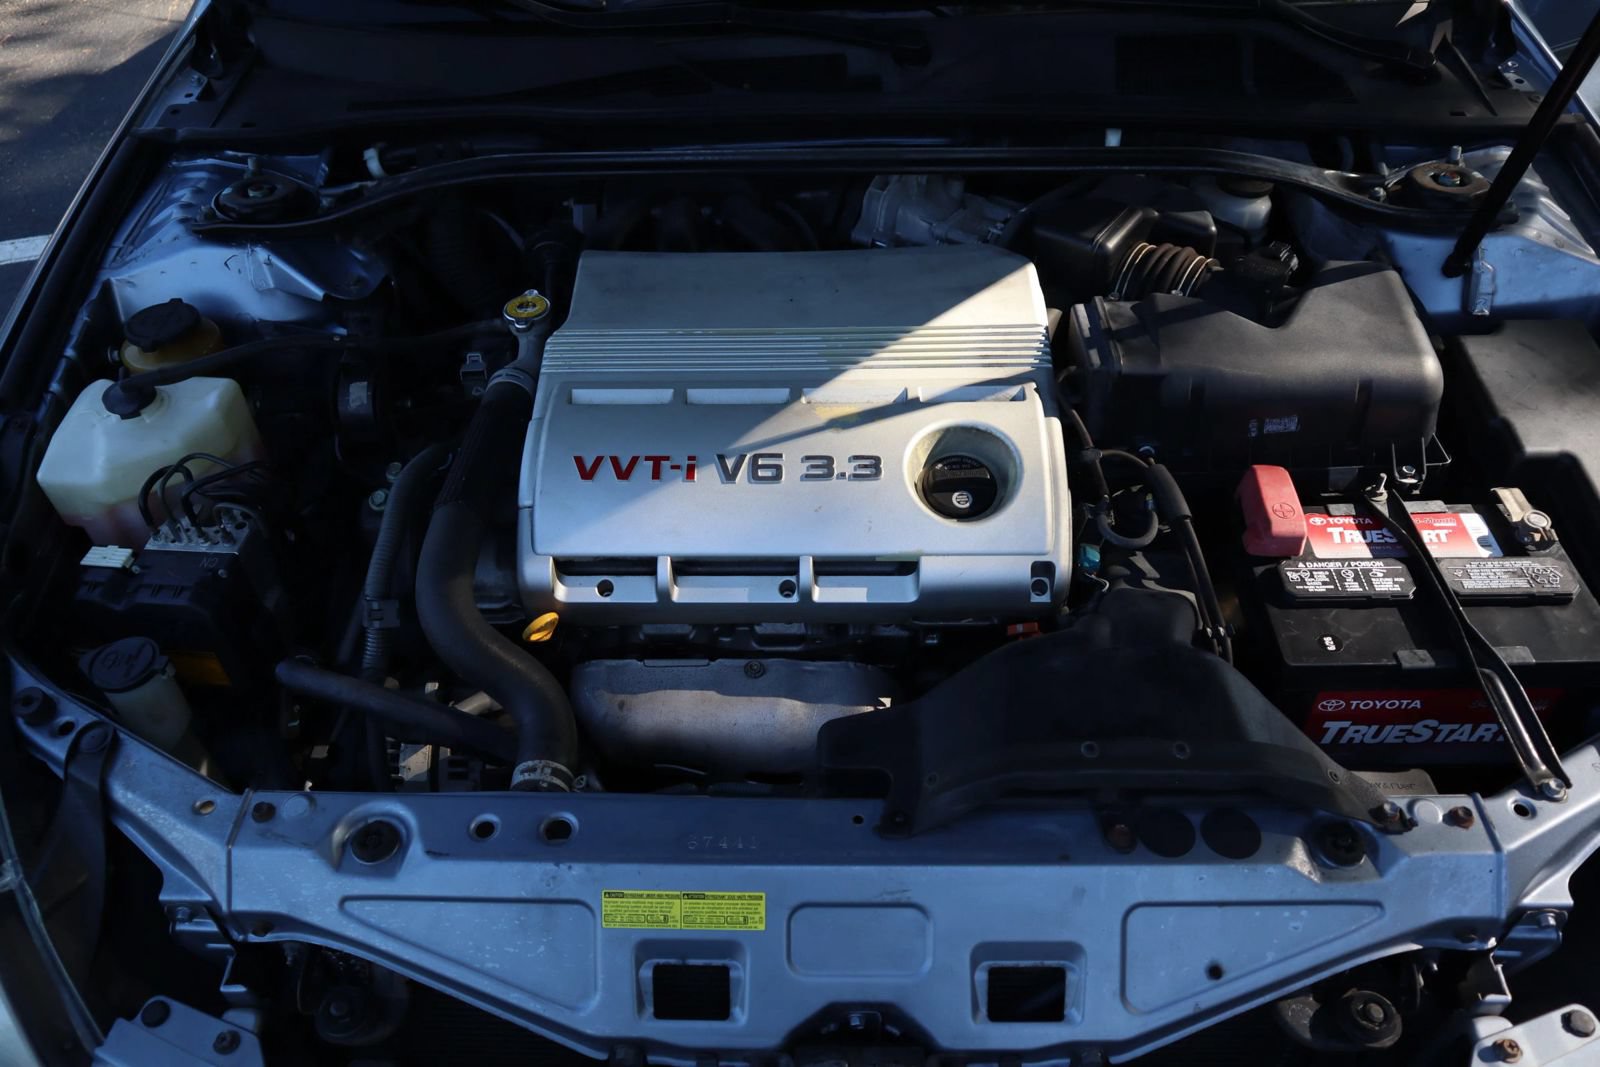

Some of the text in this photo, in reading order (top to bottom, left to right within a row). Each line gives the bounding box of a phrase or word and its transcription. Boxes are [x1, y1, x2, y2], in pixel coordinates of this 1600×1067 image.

[573, 453, 884, 484] VVT-i V6 3.3
[1327, 517, 1373, 525] TOYOTA
[1350, 699, 1423, 710] TOYOTA
[1319, 719, 1505, 744] TRUESTAR
